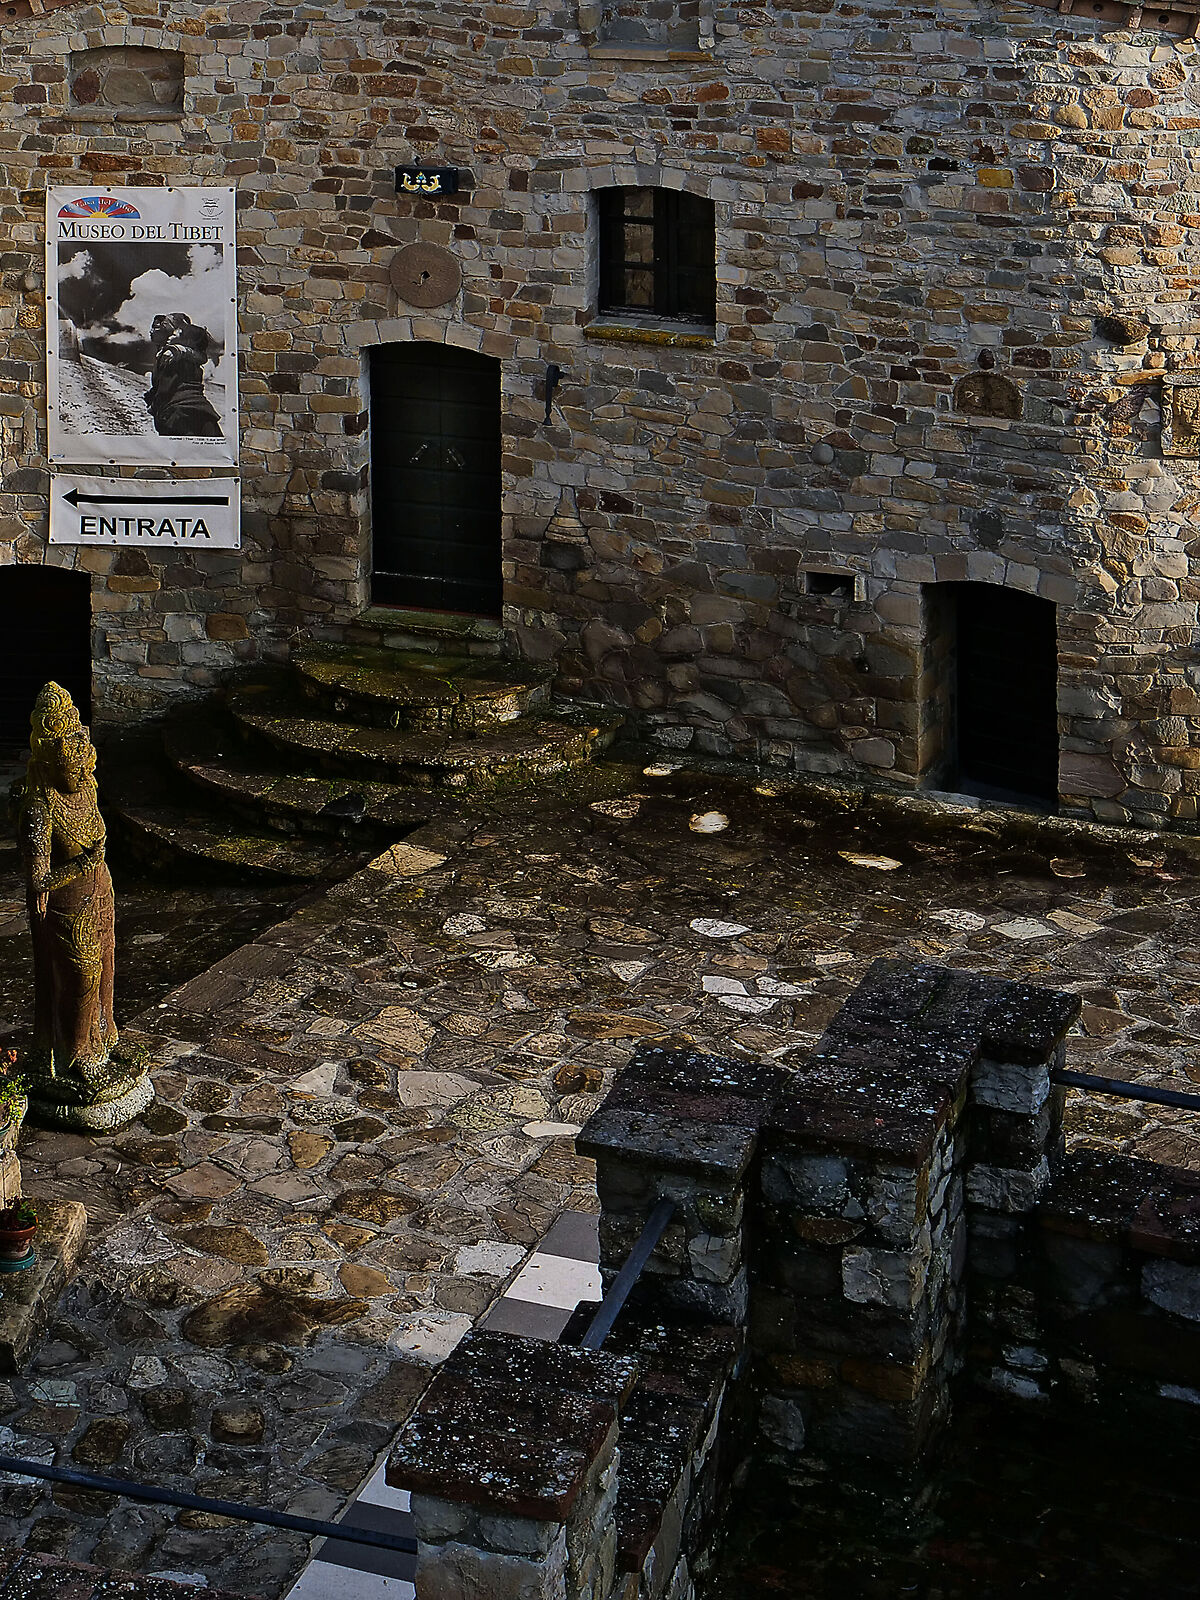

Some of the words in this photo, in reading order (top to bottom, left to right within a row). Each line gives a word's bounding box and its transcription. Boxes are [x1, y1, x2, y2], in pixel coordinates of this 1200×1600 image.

[57, 221, 125, 239] MUSEO
[131, 226, 166, 239] DEL
[168, 222, 224, 240] TIBET
[80, 515, 211, 539] ENTRATA
